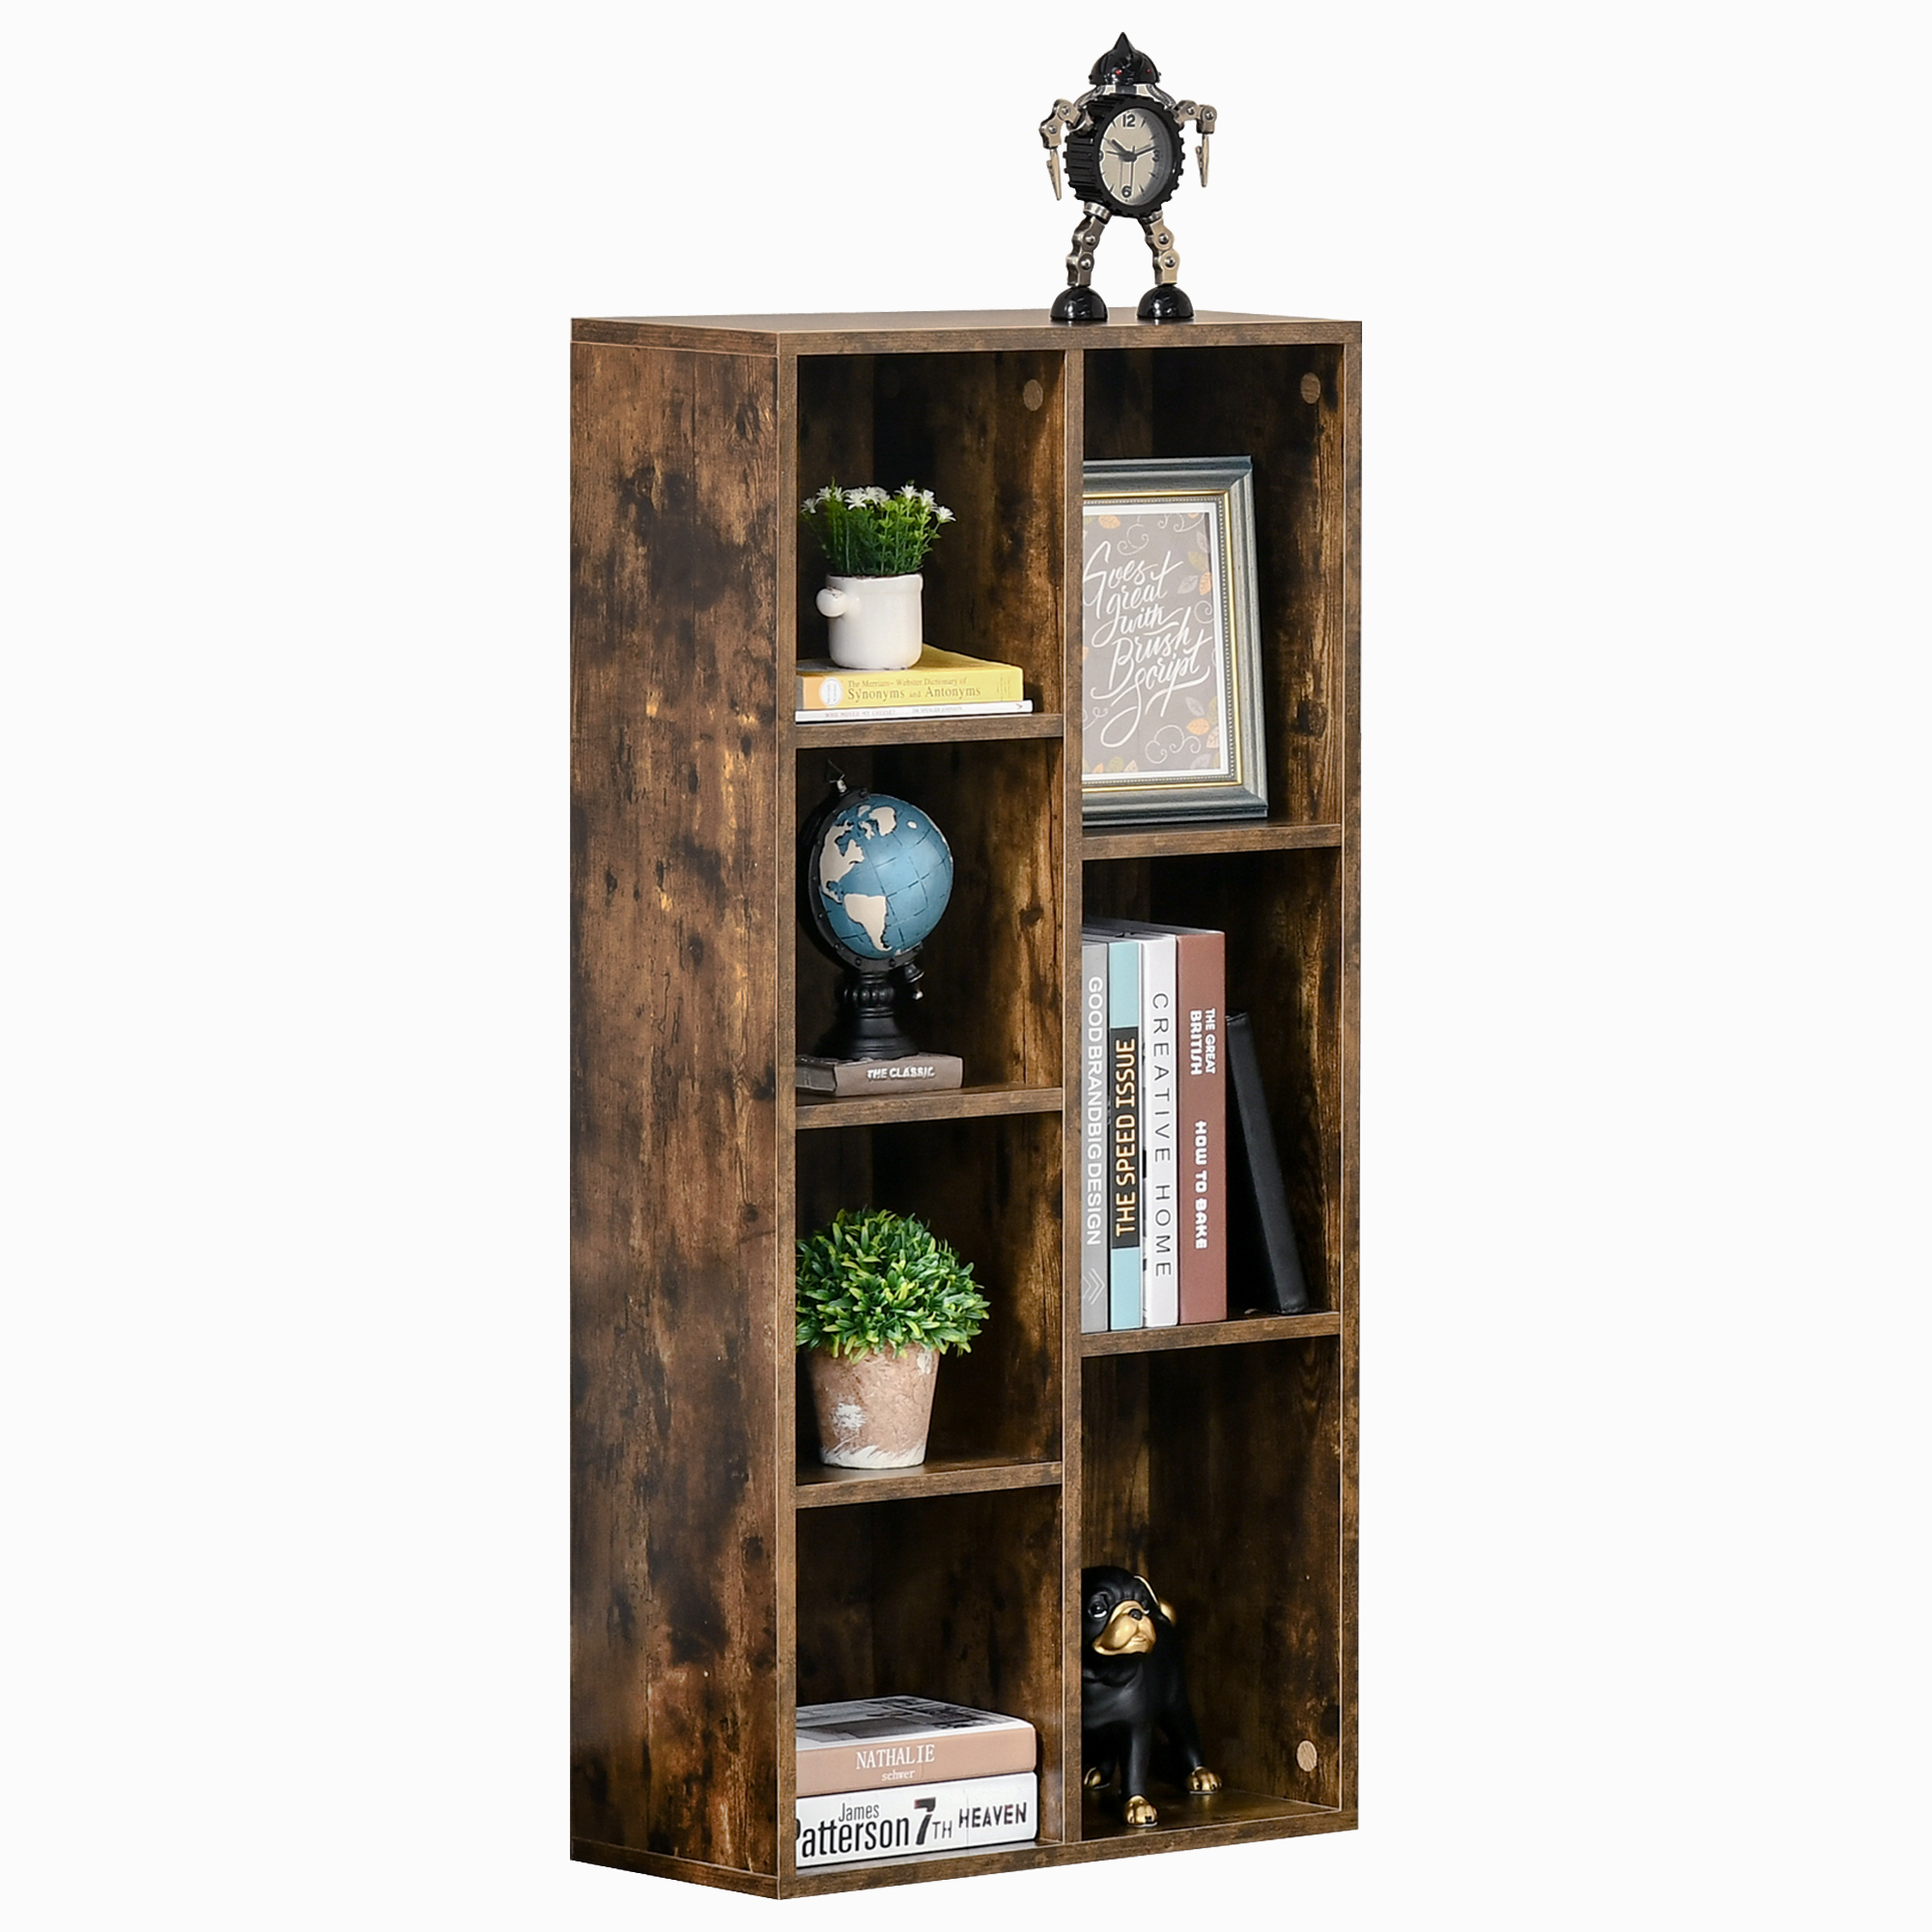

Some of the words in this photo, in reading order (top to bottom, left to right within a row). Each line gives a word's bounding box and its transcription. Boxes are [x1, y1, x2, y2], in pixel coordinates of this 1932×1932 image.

[1122, 114, 1136, 128] 12
[1121, 185, 1132, 199] 6
[1082, 541, 1158, 619] Goes
[1120, 603, 1183, 635] with
[1090, 606, 1192, 699] Brush
[847, 688, 905, 703] Synonyms
[924, 686, 981, 699] Antonyms
[923, 677, 957, 687] Dictionary
[1205, 1008, 1216, 1031] THE
[1190, 1009, 1203, 1075] BRITISH
[1205, 1034, 1216, 1074] GREAT
[867, 1067, 888, 1079] THE
[889, 1066, 936, 1078] CLASSIC
[1115, 1038, 1136, 1109] ISSUE
[1152, 993, 1171, 1163] CREATIVE
[1115, 1114, 1136, 1186] SPEED
[1195, 1121, 1208, 1165] HOW
[1195, 1170, 1208, 1193] TO
[1087, 1163, 1102, 1245] DESIGN
[1115, 1191, 1136, 1237] THE
[1195, 1198, 1208, 1249] BAKE
[1155, 1184, 1172, 1277] HOME
[856, 1744, 935, 1770] NATHALIE
[838, 1803, 880, 1822] James
[958, 1802, 1027, 1829] HEAVEN
